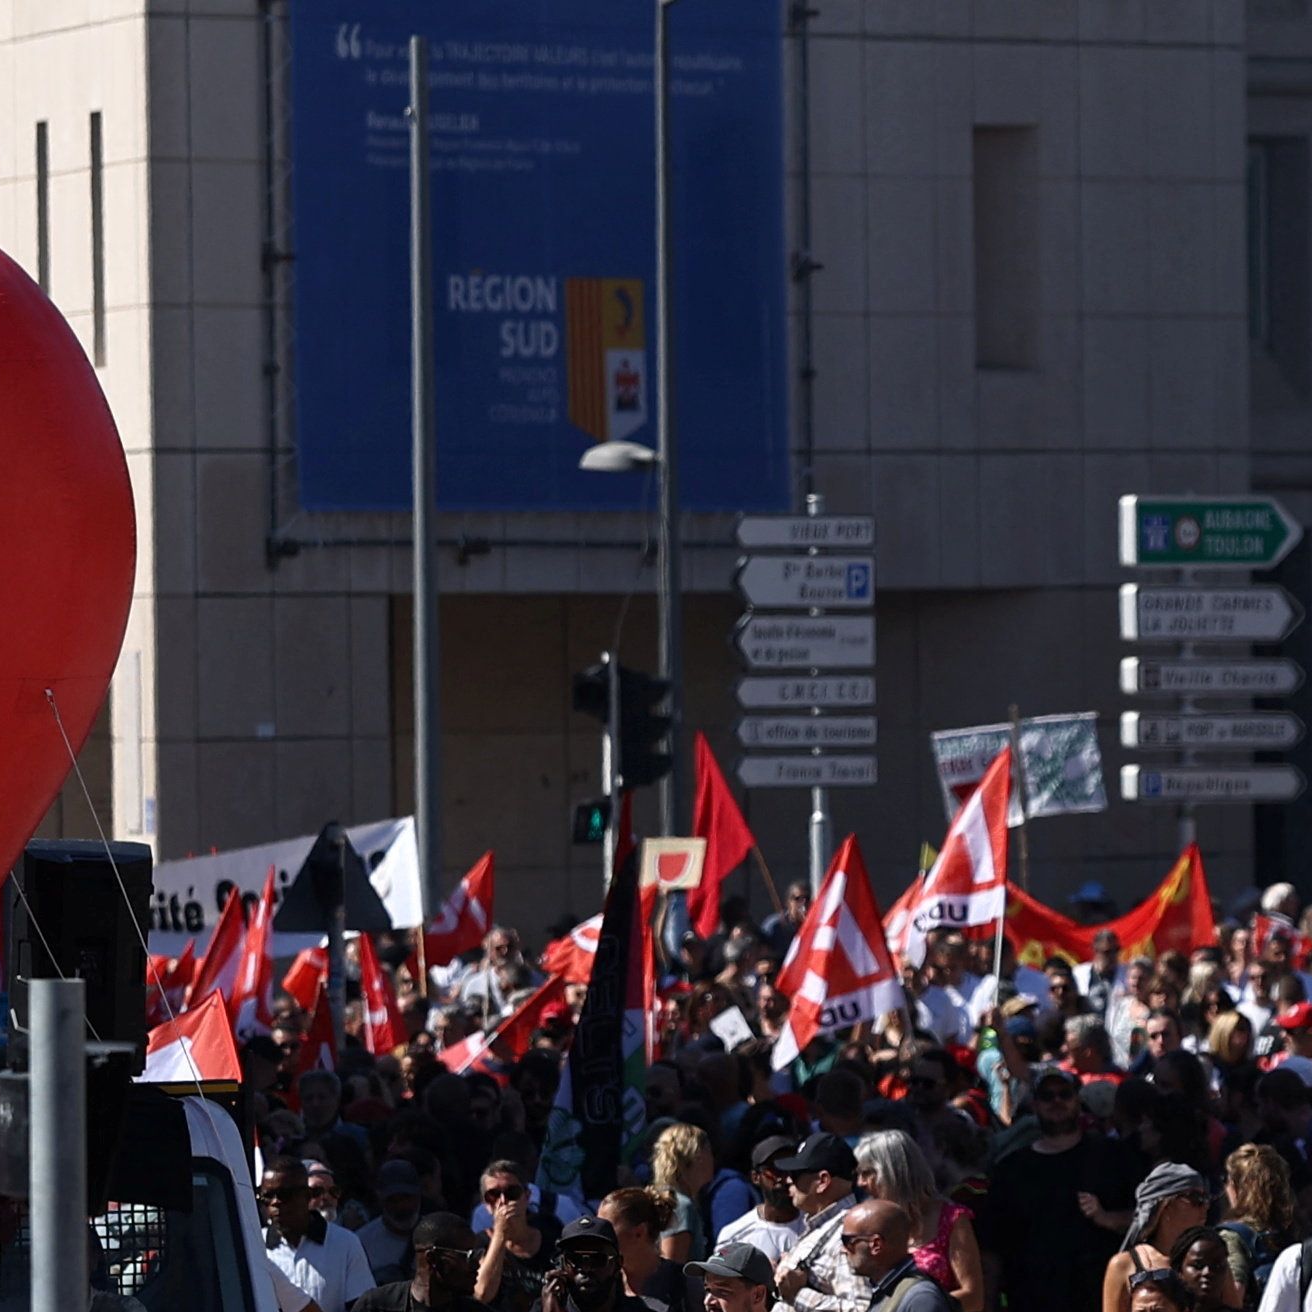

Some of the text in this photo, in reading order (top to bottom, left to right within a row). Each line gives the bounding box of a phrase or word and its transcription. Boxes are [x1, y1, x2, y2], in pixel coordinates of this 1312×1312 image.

[499, 319, 560, 359] SUD
[1204, 509, 1273, 532] AUBAGNE
[1205, 534, 1265, 556] TOULON
